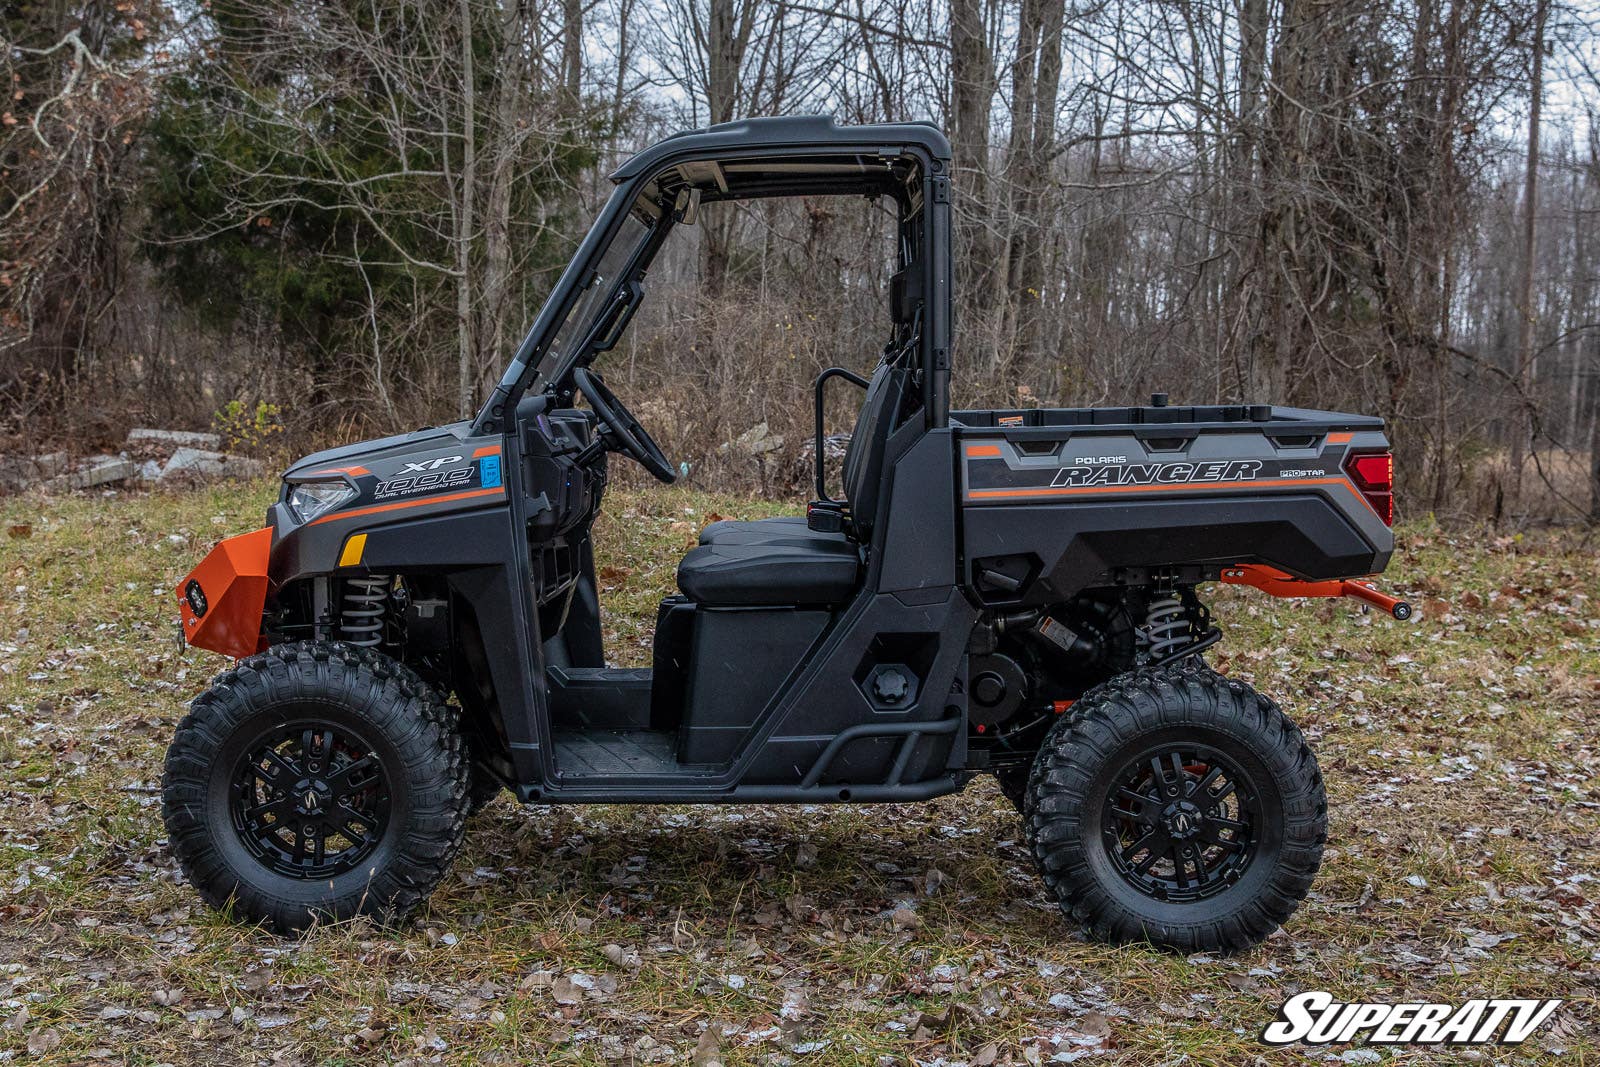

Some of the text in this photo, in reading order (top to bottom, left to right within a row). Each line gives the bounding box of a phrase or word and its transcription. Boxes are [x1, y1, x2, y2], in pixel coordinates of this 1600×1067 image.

[394, 455, 464, 475] XP
[1075, 456, 1127, 465] POLARIS
[375, 466, 475, 495] 1000
[1050, 460, 1263, 487] RANGER
[1280, 469, 1325, 478] PROSTAR
[375, 492, 399, 500] DUAL
[401, 482, 449, 495] OVERHEAD
